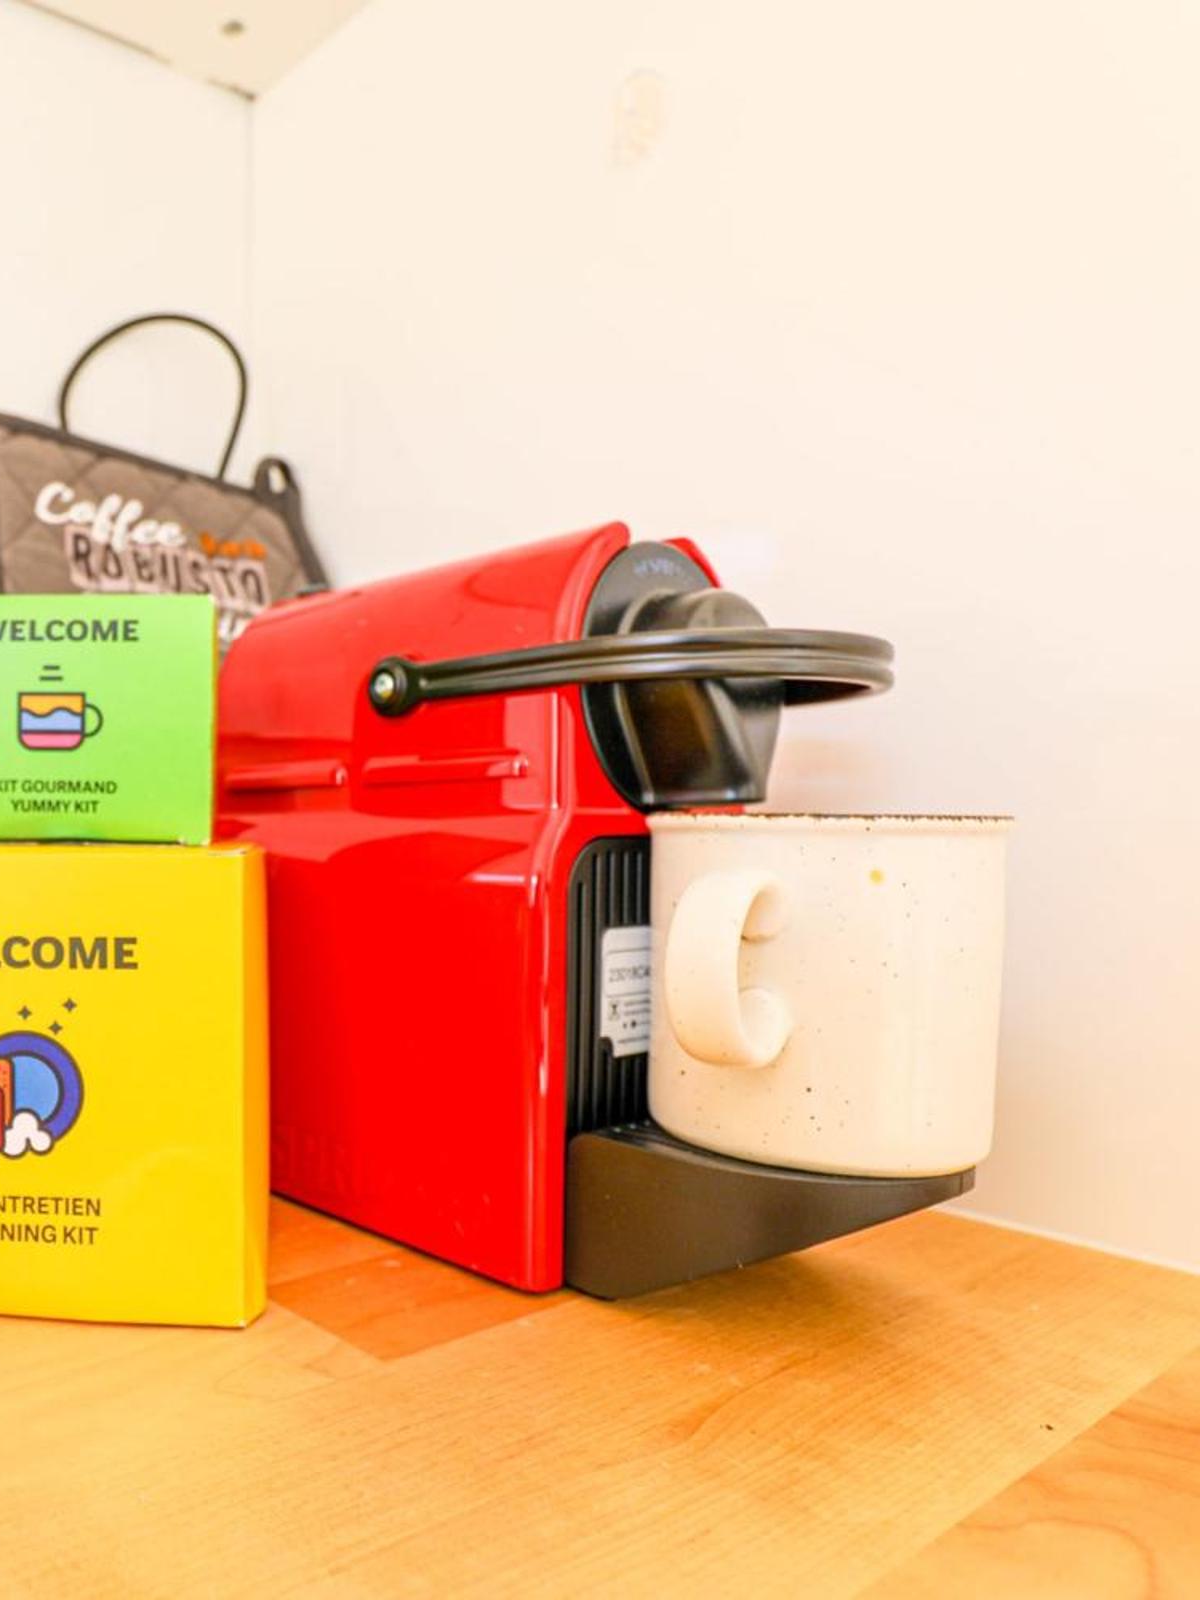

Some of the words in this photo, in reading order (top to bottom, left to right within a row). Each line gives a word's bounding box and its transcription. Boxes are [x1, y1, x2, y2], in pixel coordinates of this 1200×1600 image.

[34, 481, 186, 553] Coffee
[21, 779, 118, 795] GOURMAND
[11, 799, 71, 813] YUMMY
[74, 800, 99, 814] KIT
[62, 1225, 99, 1245] KIT
